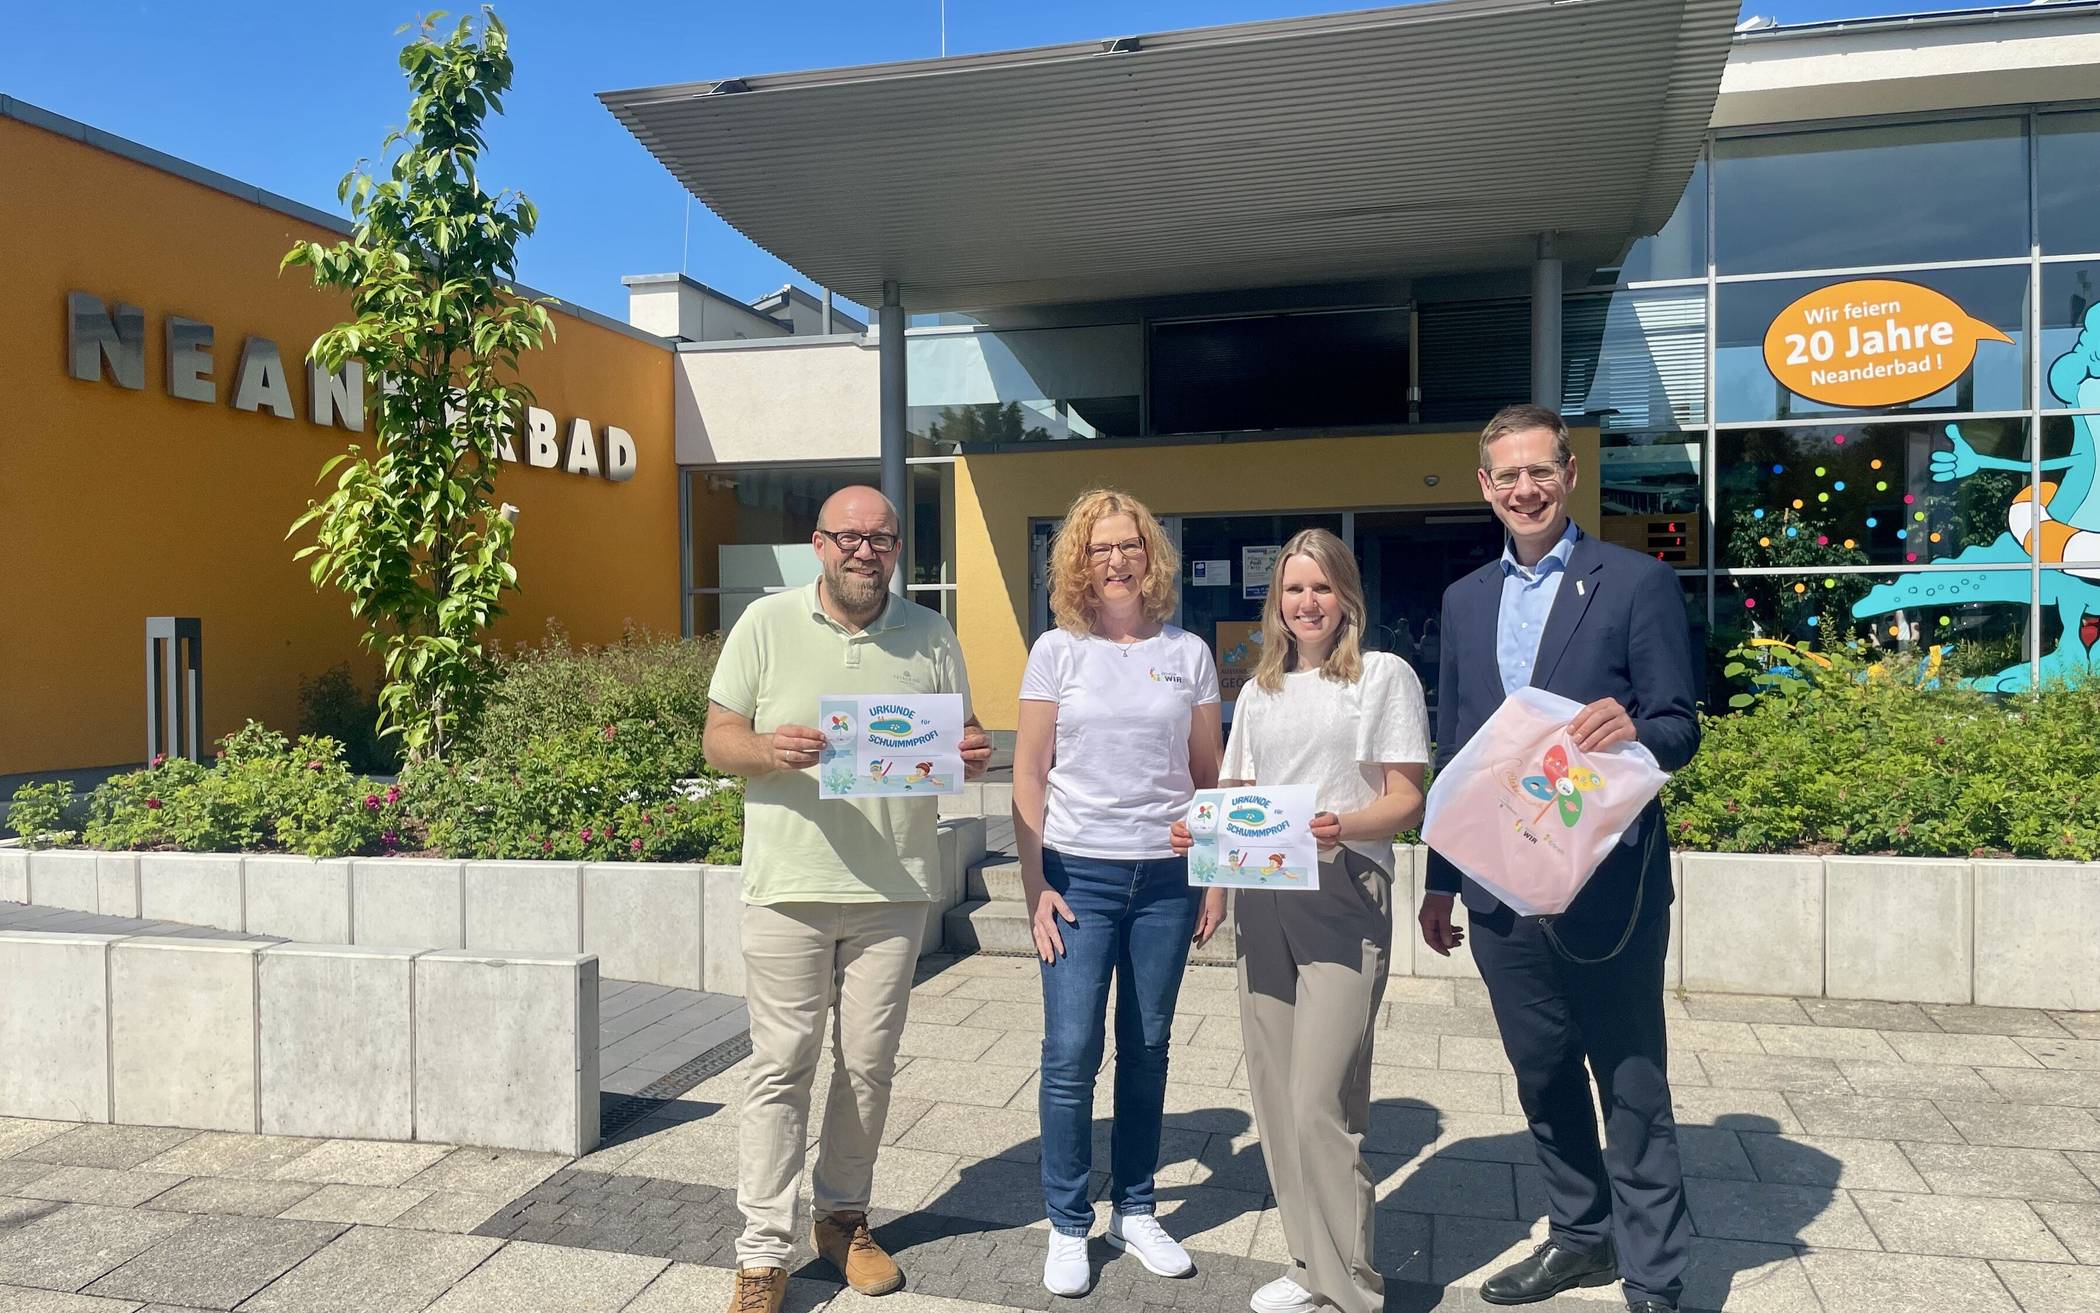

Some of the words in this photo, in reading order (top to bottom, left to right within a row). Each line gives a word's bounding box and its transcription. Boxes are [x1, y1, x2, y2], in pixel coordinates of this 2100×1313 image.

[1804, 307, 1839, 325] Wir
[1844, 300, 1901, 320] feiern
[1784, 329, 1835, 366] 20
[1845, 318, 1954, 359] Jahre
[1811, 354, 1931, 387] Neanderbad
[1936, 353, 1943, 371] !
[68, 291, 637, 482] NEANERBAD
[1164, 675, 1182, 684] WIR
[869, 704, 916, 720] URKUNDE
[868, 730, 939, 748] SCHWIMMPROFI
[1231, 795, 1272, 809] URKUNDE
[1226, 820, 1291, 838] SCHWIMMPROFI
[1523, 830, 1539, 845] WIR
